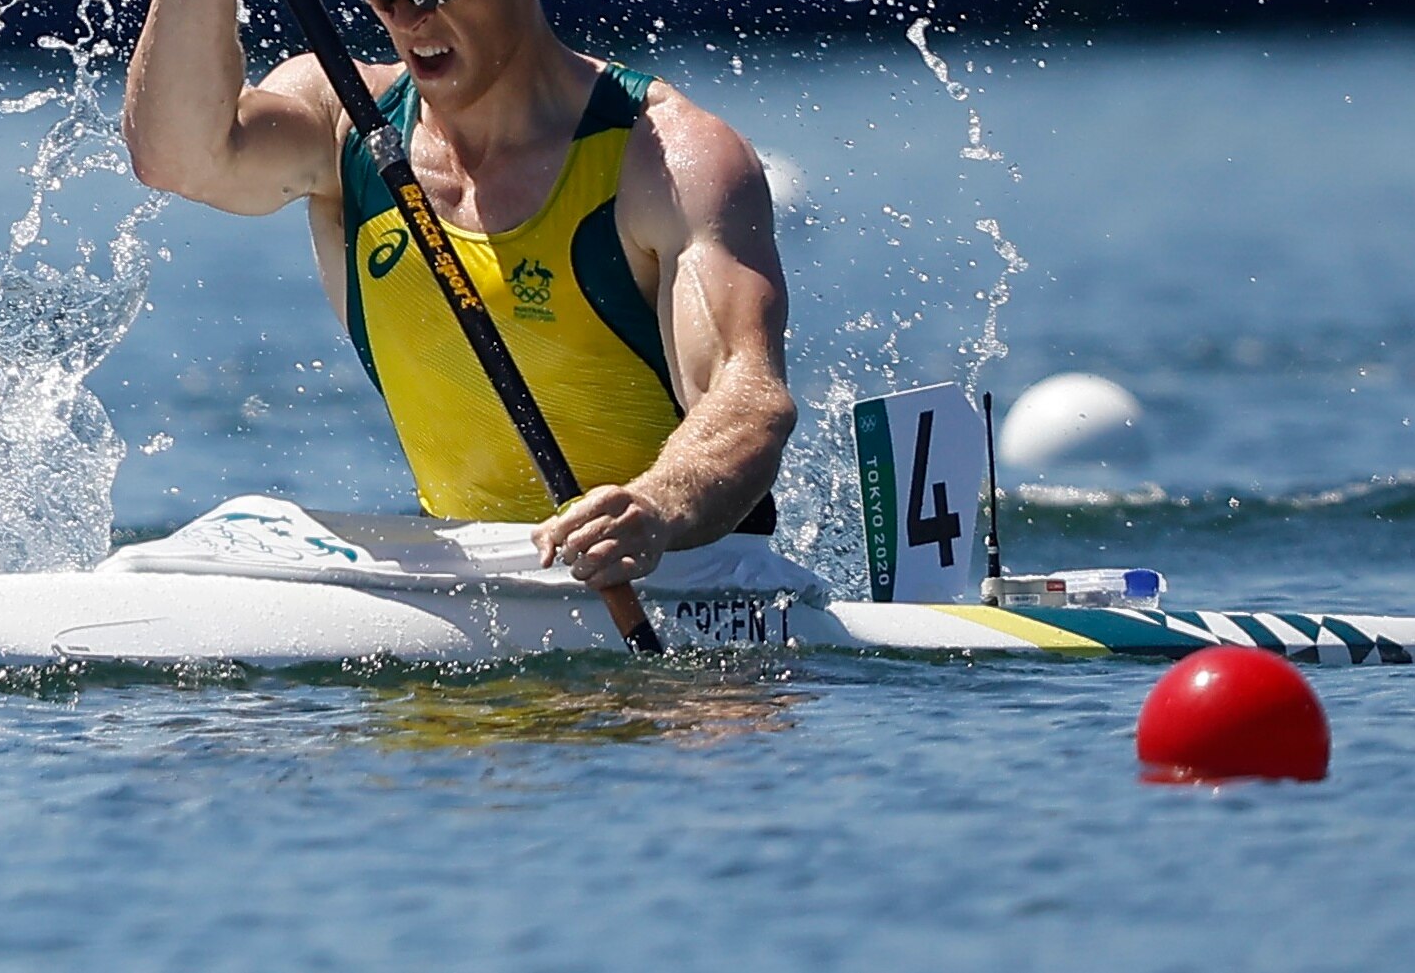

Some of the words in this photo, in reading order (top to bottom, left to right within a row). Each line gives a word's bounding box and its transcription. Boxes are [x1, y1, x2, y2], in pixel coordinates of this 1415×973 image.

[866, 455, 884, 527] TOKYO
[907, 410, 961, 568] 4
[874, 533, 890, 586] 2020
